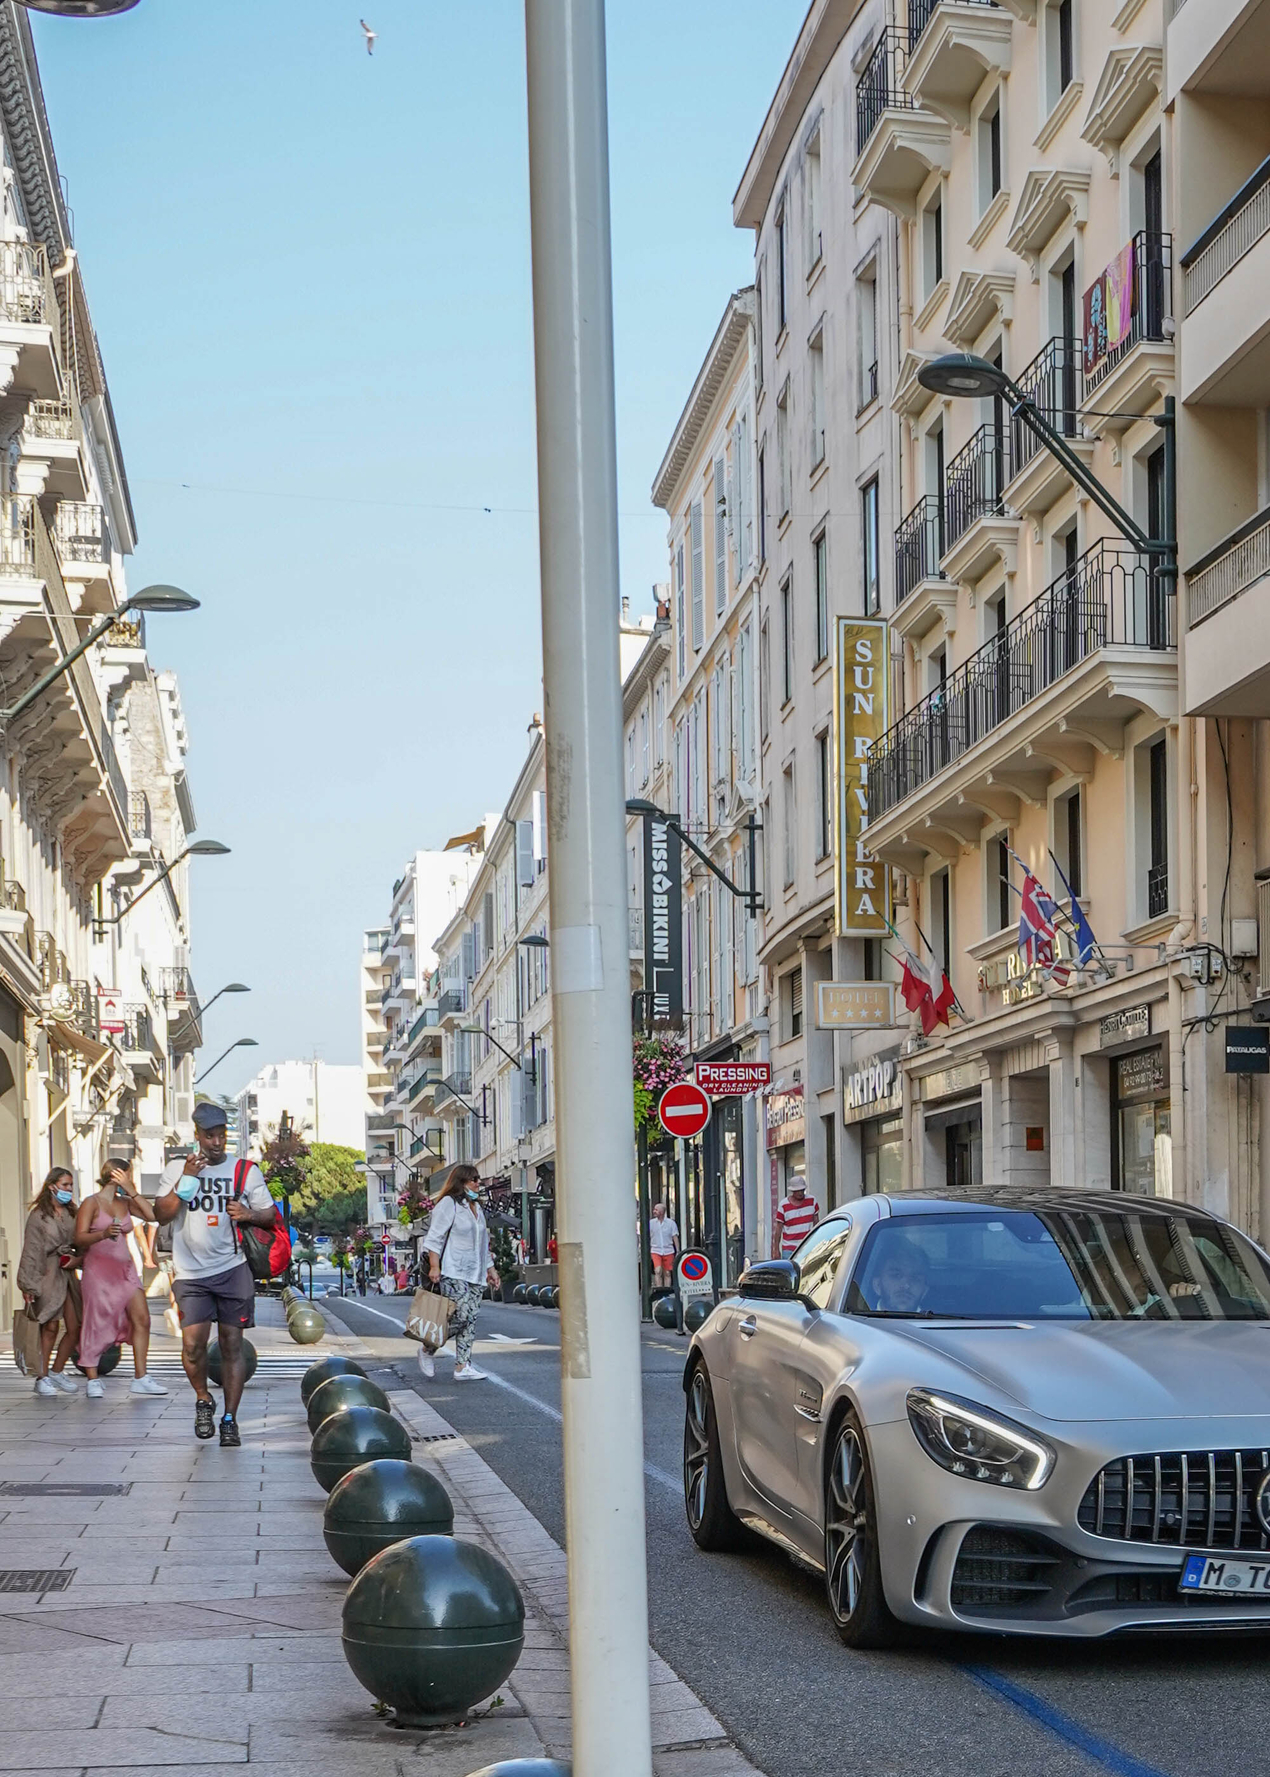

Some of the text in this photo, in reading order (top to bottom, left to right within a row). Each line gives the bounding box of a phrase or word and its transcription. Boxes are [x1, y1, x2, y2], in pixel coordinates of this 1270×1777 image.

[853, 640, 874, 715] SUN
[651, 822, 669, 961] MISS BIKINI
[1226, 1046, 1267, 1054] PATAUGAS
[698, 1065, 768, 1081] PRESSING
[849, 1061, 893, 1109] ARTPOP
[1203, 1562, 1226, 1586] M
